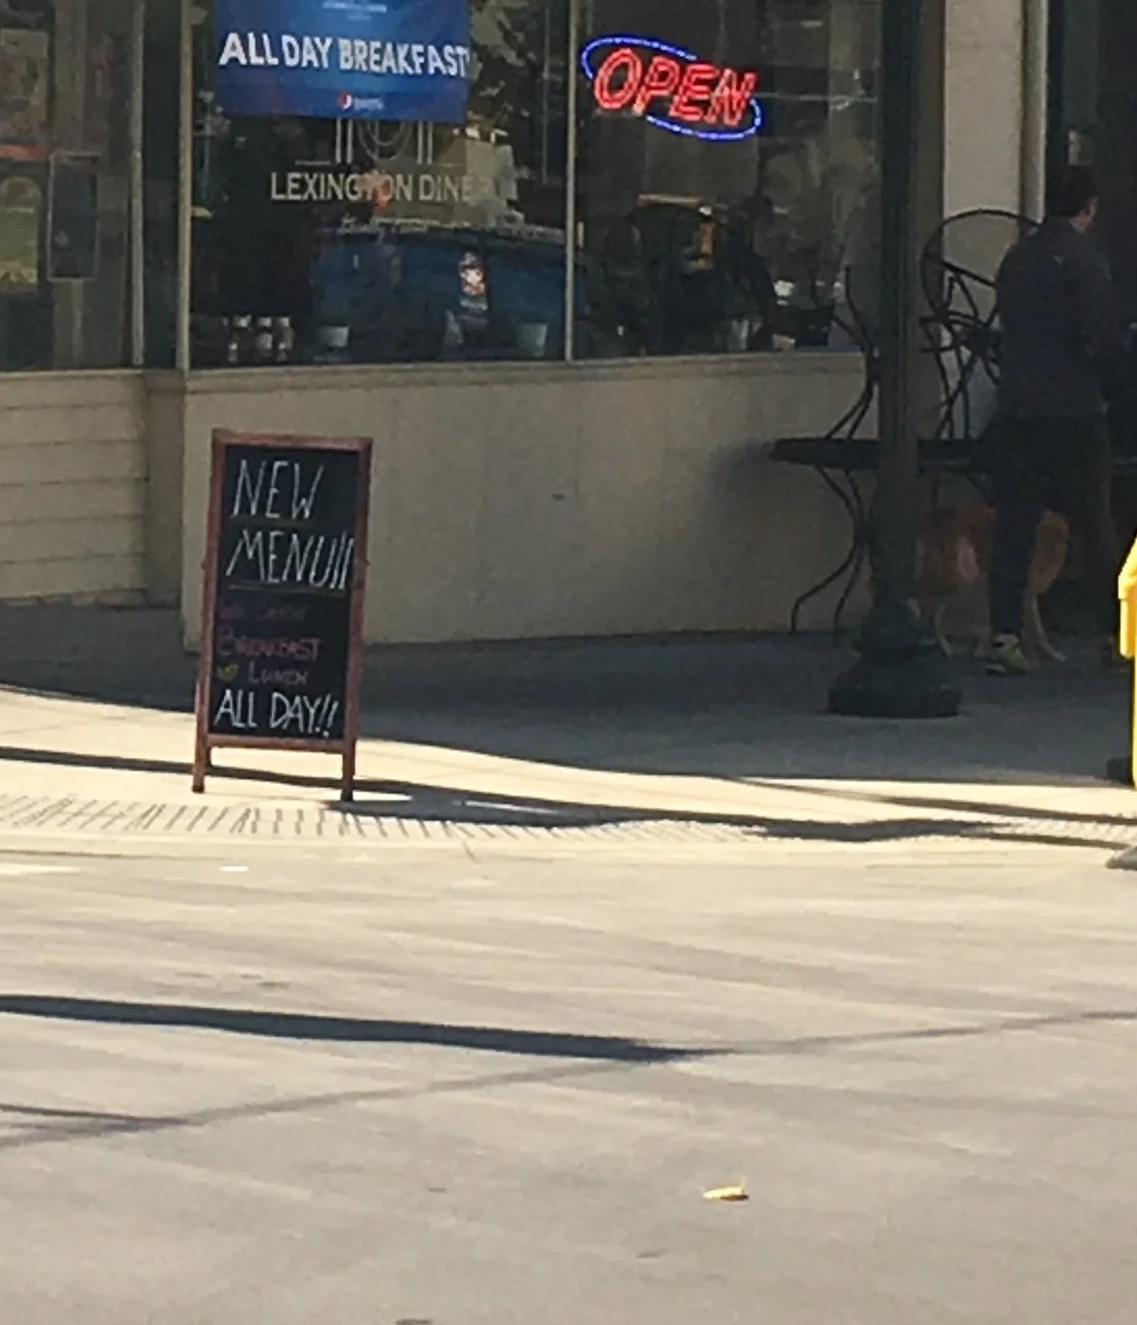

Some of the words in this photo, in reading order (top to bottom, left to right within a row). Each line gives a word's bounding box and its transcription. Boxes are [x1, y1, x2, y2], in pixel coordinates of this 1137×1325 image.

[219, 32, 279, 66] ALL
[281, 34, 333, 69] DAY
[338, 38, 469, 77] BREAKFAST
[595, 48, 757, 125] OPEN
[271, 172, 412, 201] LEXINGTON
[230, 458, 325, 519] NEW
[214, 689, 257, 728] ALL
[269, 691, 339, 737] DAY!!
